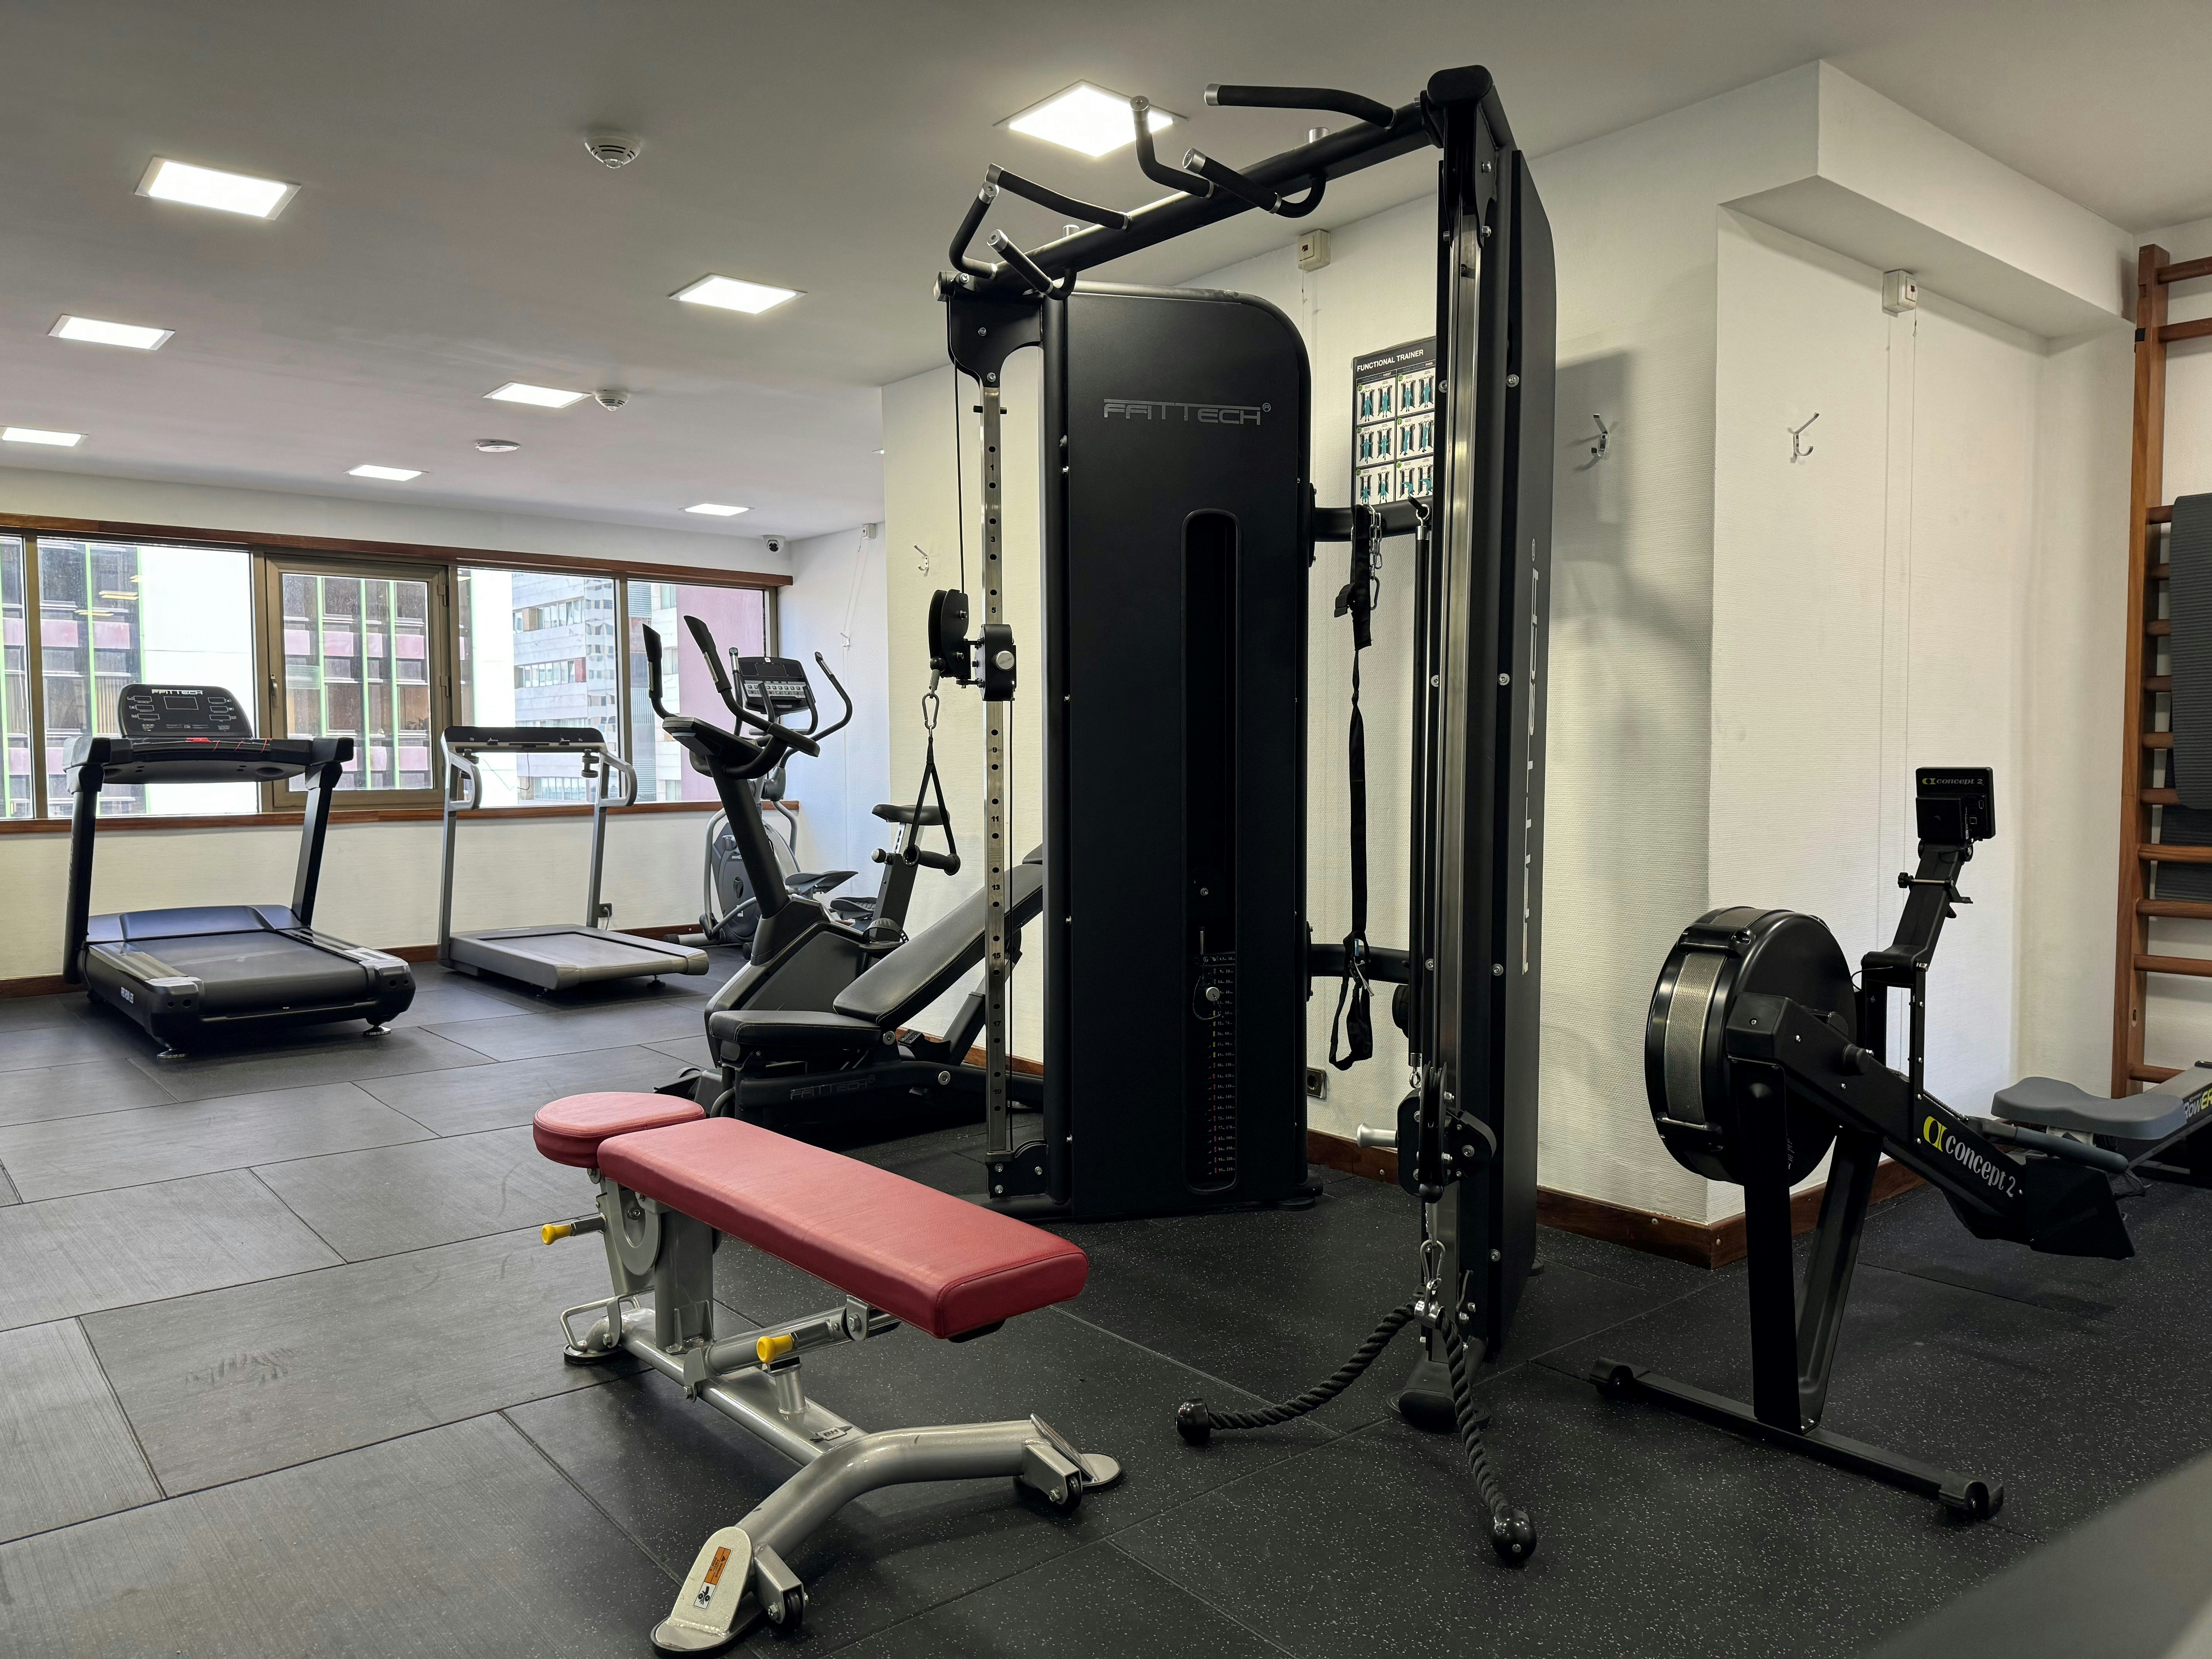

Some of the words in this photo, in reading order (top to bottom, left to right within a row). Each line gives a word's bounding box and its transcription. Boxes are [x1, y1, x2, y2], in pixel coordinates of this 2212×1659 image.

[1357, 357, 1395, 372] FUNCTIONAL
[1396, 349, 1424, 362] TRAINER
[1945, 1135, 2006, 1190] concept
[2006, 1176, 2016, 1197] 2
